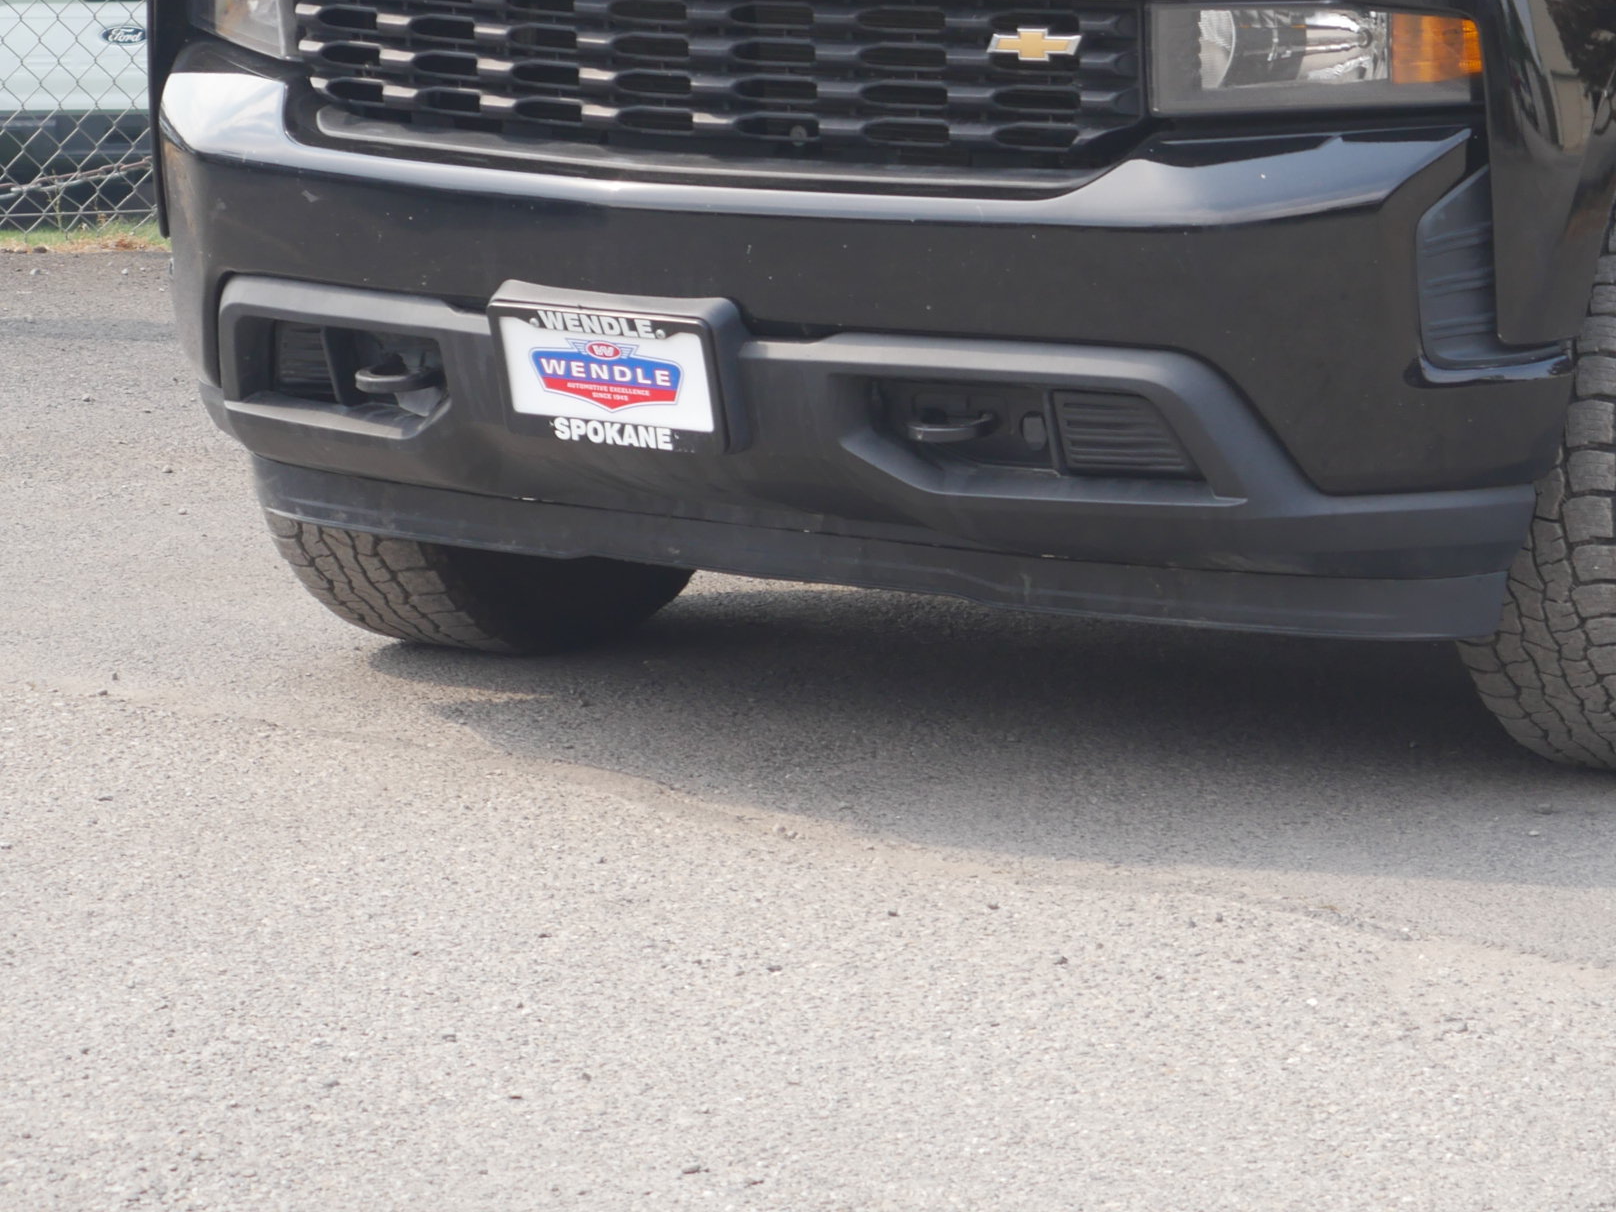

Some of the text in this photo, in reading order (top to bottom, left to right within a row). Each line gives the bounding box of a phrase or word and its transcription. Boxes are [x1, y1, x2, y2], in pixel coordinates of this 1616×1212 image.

[108, 27, 143, 43] Ford
[537, 310, 655, 339] WENDLE
[540, 357, 671, 387] WENDLE
[567, 382, 650, 396] AUTOMOTIVE EXCELLENCE
[553, 417, 674, 451] SPOKANE
